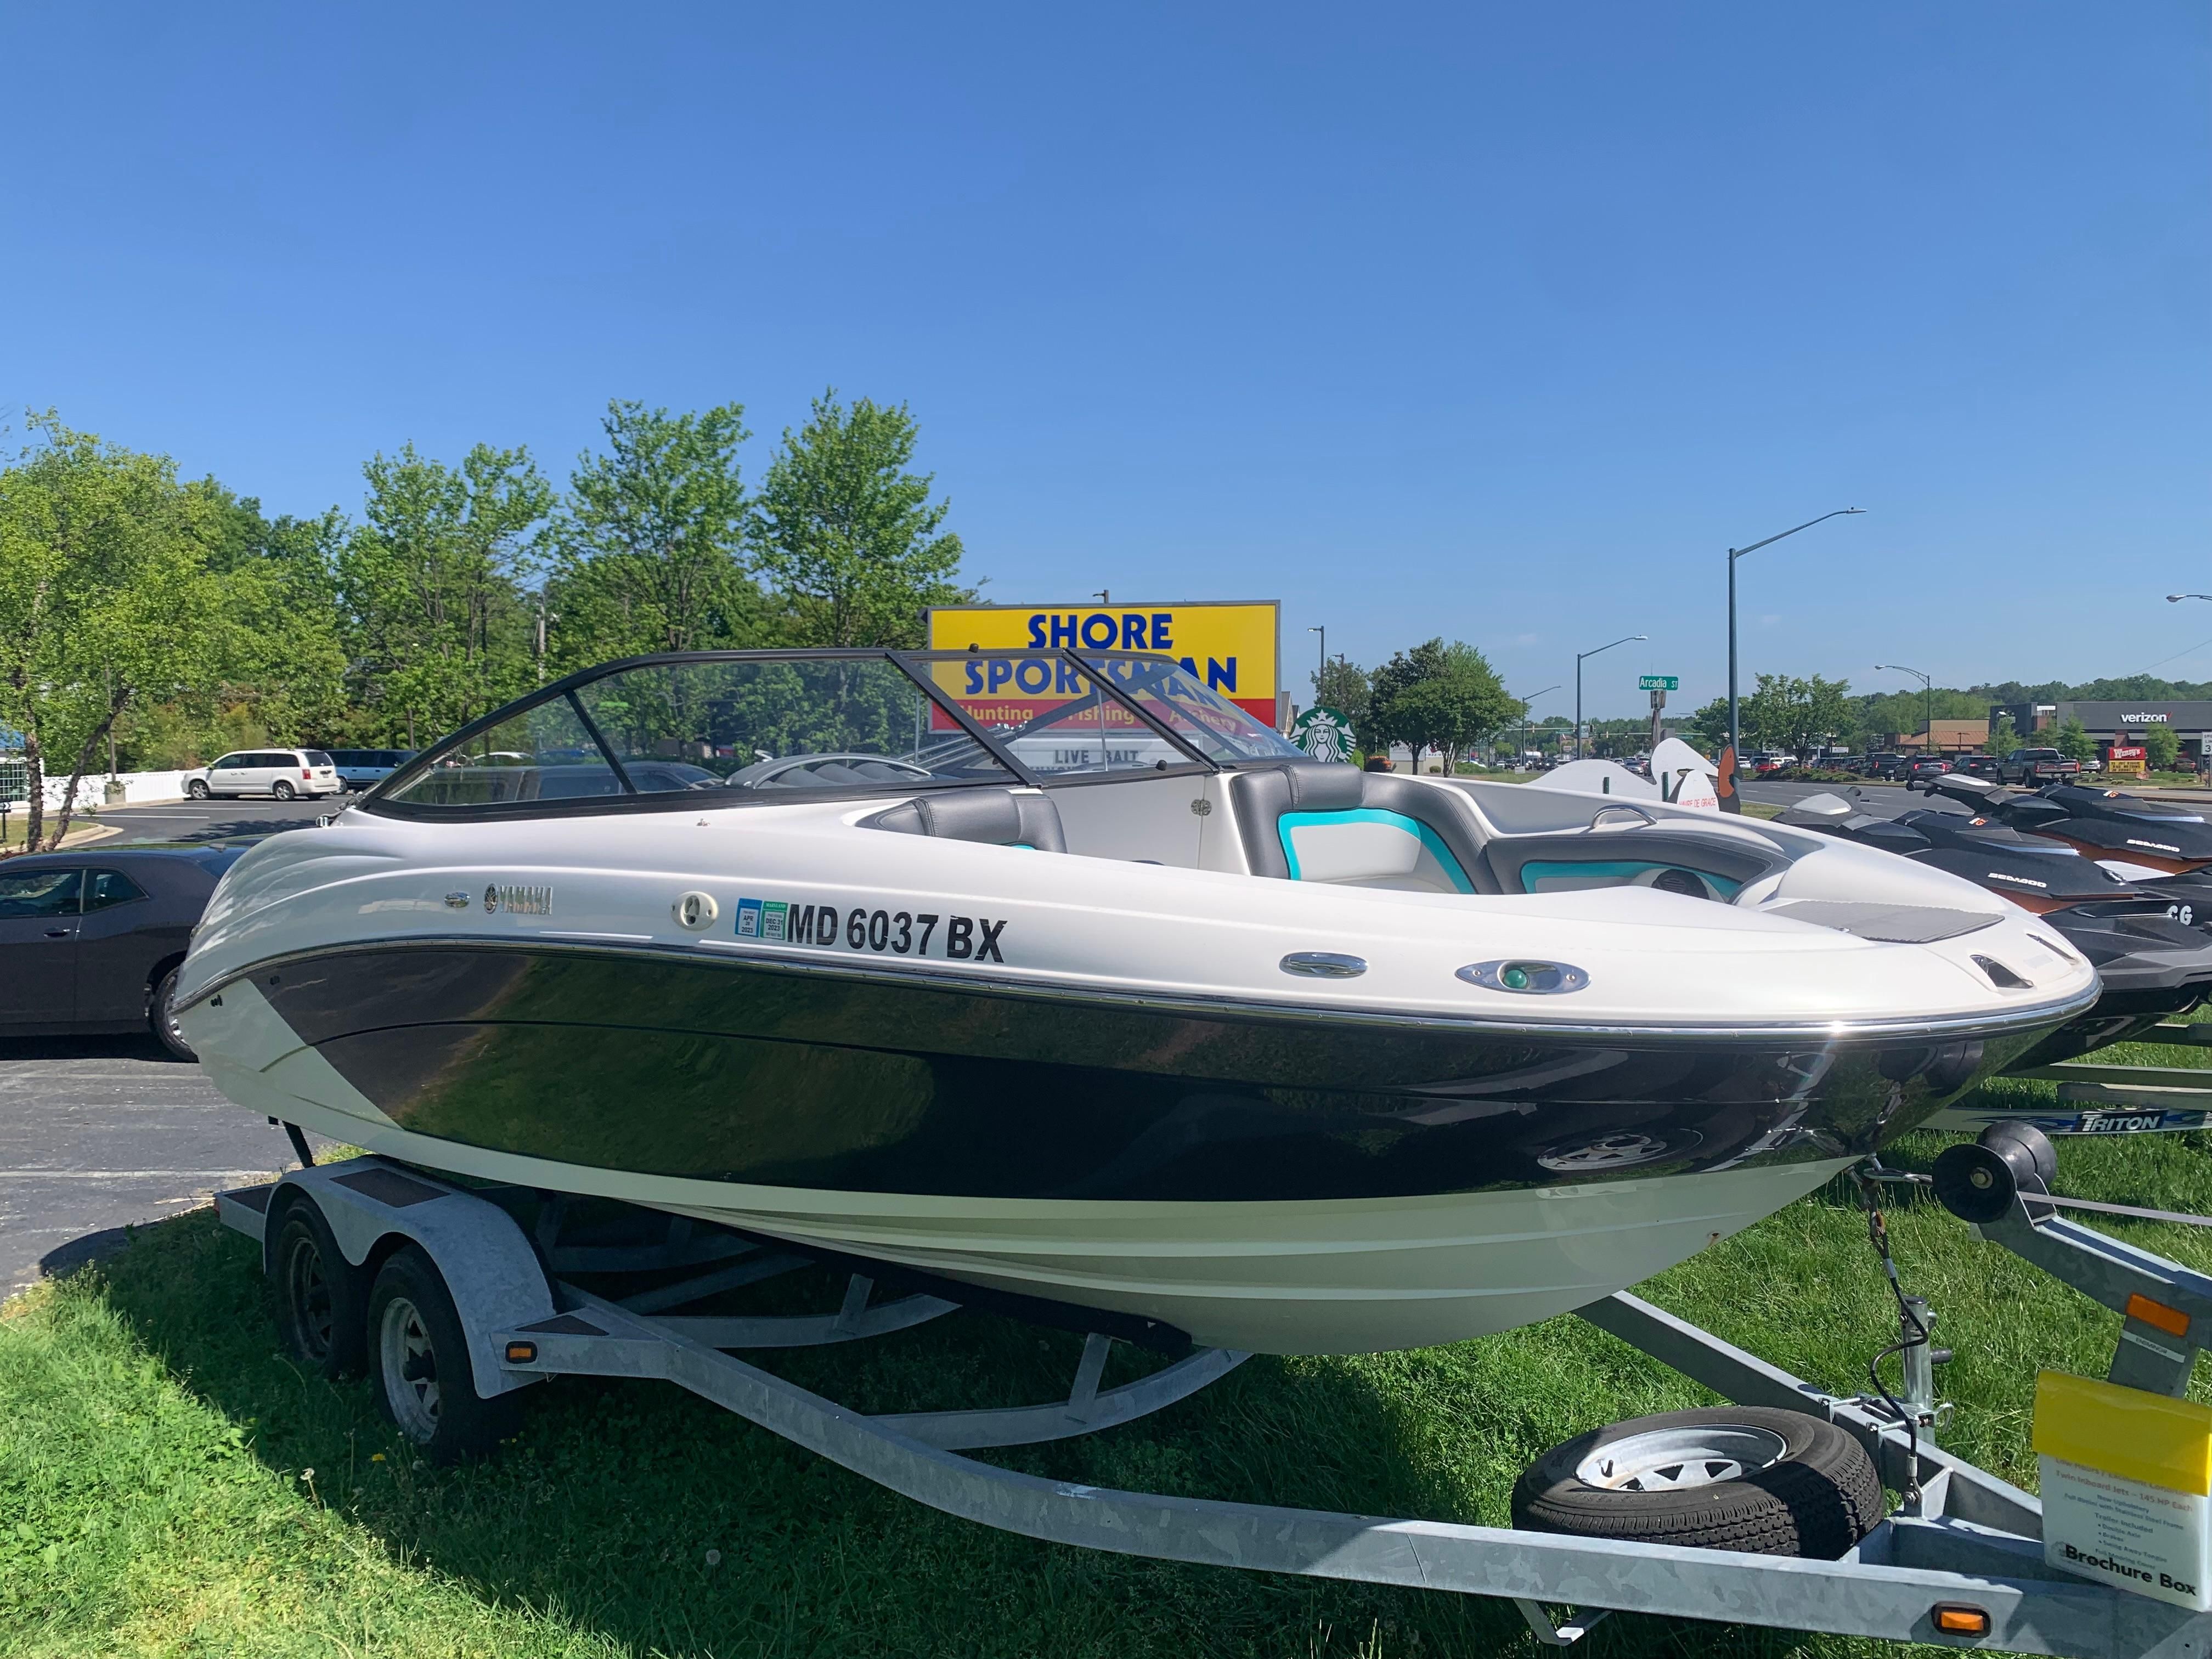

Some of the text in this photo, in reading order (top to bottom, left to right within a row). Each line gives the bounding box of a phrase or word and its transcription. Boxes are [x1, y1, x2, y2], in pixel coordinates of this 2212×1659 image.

[1028, 613, 1173, 650] SHORE
[1639, 677, 1667, 688] Arcadia
[1068, 705, 1136, 725] ishing
[2120, 712, 2168, 723] verizon
[1054, 749, 1139, 764] LIVE BAIT
[1694, 799, 1700, 808] DE
[1701, 797, 1716, 807] GRACE
[500, 885, 552, 915] YAMAHA
[787, 904, 1008, 963] MD 6037 BX
[2081, 1114, 2160, 1132] TRITON
[2056, 1470, 2076, 1481] Twin
[2077, 1476, 2111, 1491] Inboard
[2113, 1486, 2129, 1496] Jets
[2140, 1493, 2155, 1503] 145
[2157, 1497, 2170, 1505] HP
[2172, 1501, 2193, 1512] Each
[2095, 1512, 2153, 1534] Trailer Included
[2066, 1544, 2197, 1597] Brochure Box
